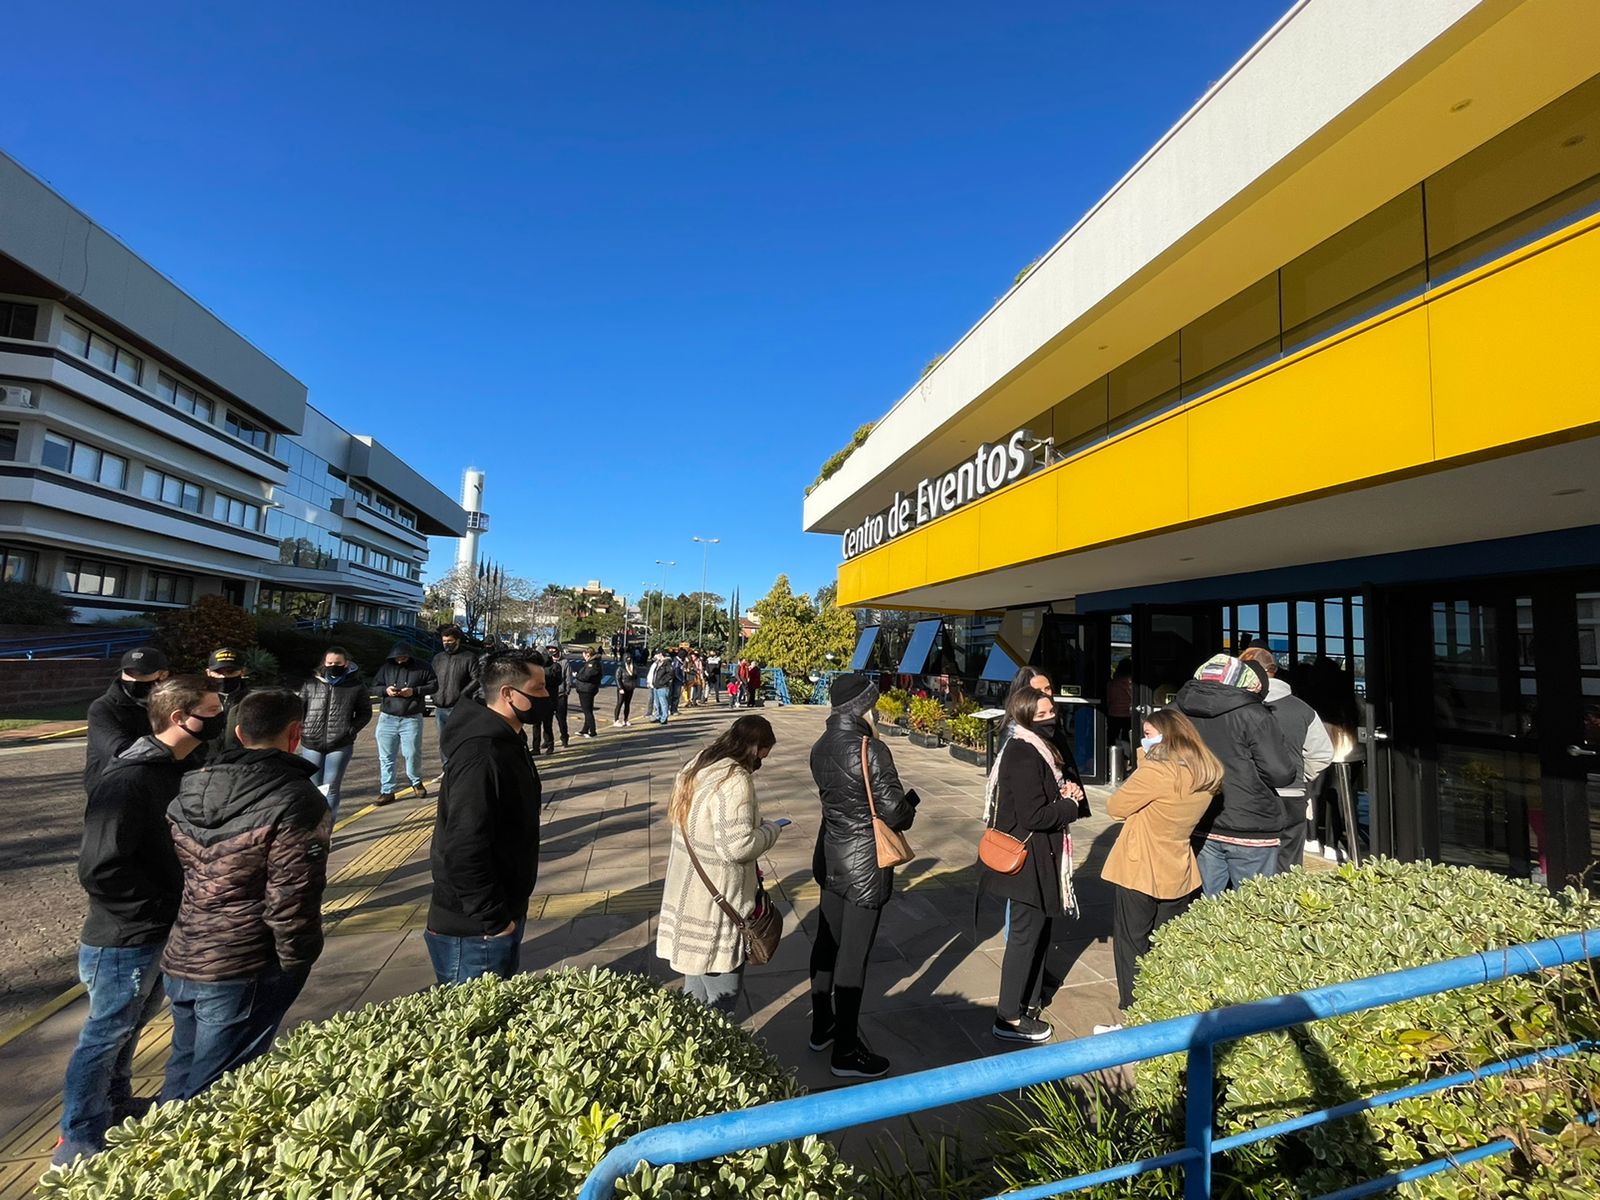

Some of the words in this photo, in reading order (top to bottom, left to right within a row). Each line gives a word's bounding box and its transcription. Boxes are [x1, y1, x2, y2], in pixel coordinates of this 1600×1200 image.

[842, 515, 884, 560] Centro
[887, 491, 910, 538] de
[916, 430, 1028, 525] Eventos
